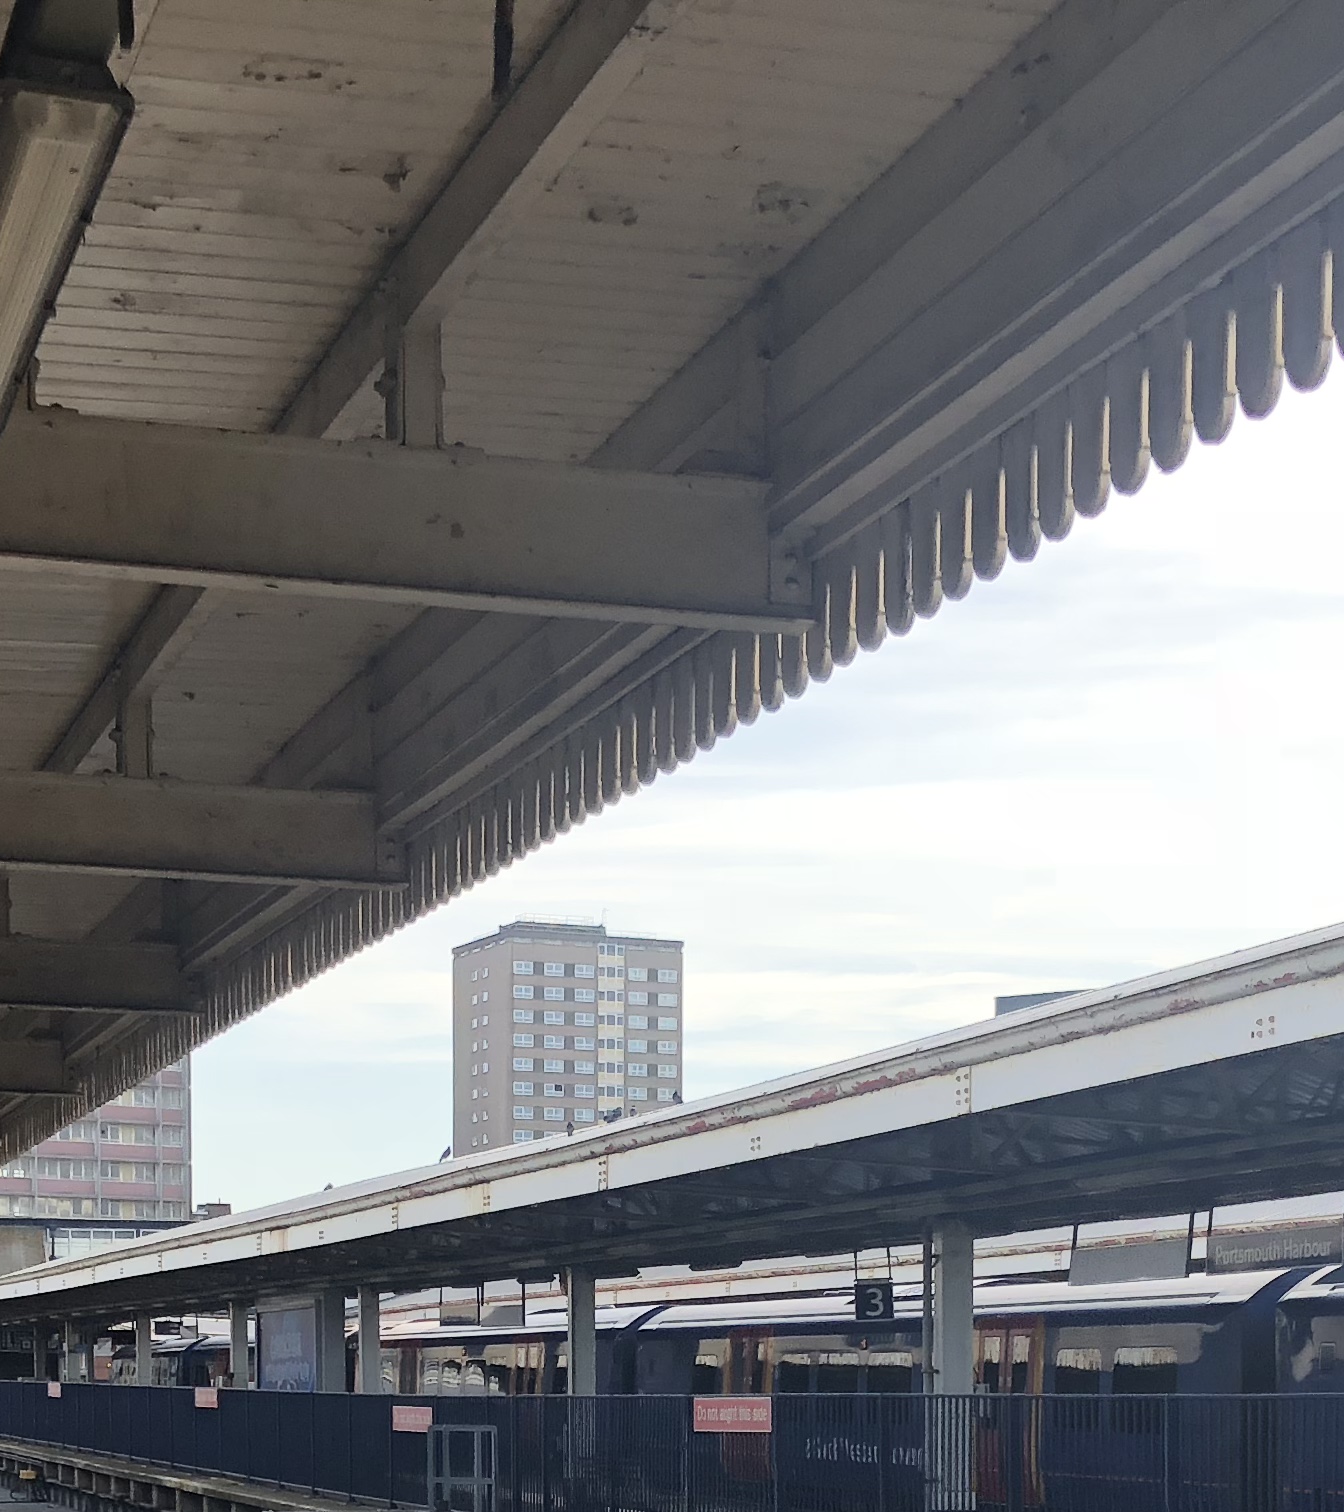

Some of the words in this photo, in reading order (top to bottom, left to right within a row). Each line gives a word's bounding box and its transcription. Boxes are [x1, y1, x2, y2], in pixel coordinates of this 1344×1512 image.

[1215, 1241, 1280, 1265] Portsmouth
[1283, 1238, 1332, 1259] Harbour
[865, 1287, 884, 1317] 3
[697, 1405, 707, 1421] Do
[707, 1407, 719, 1421] not
